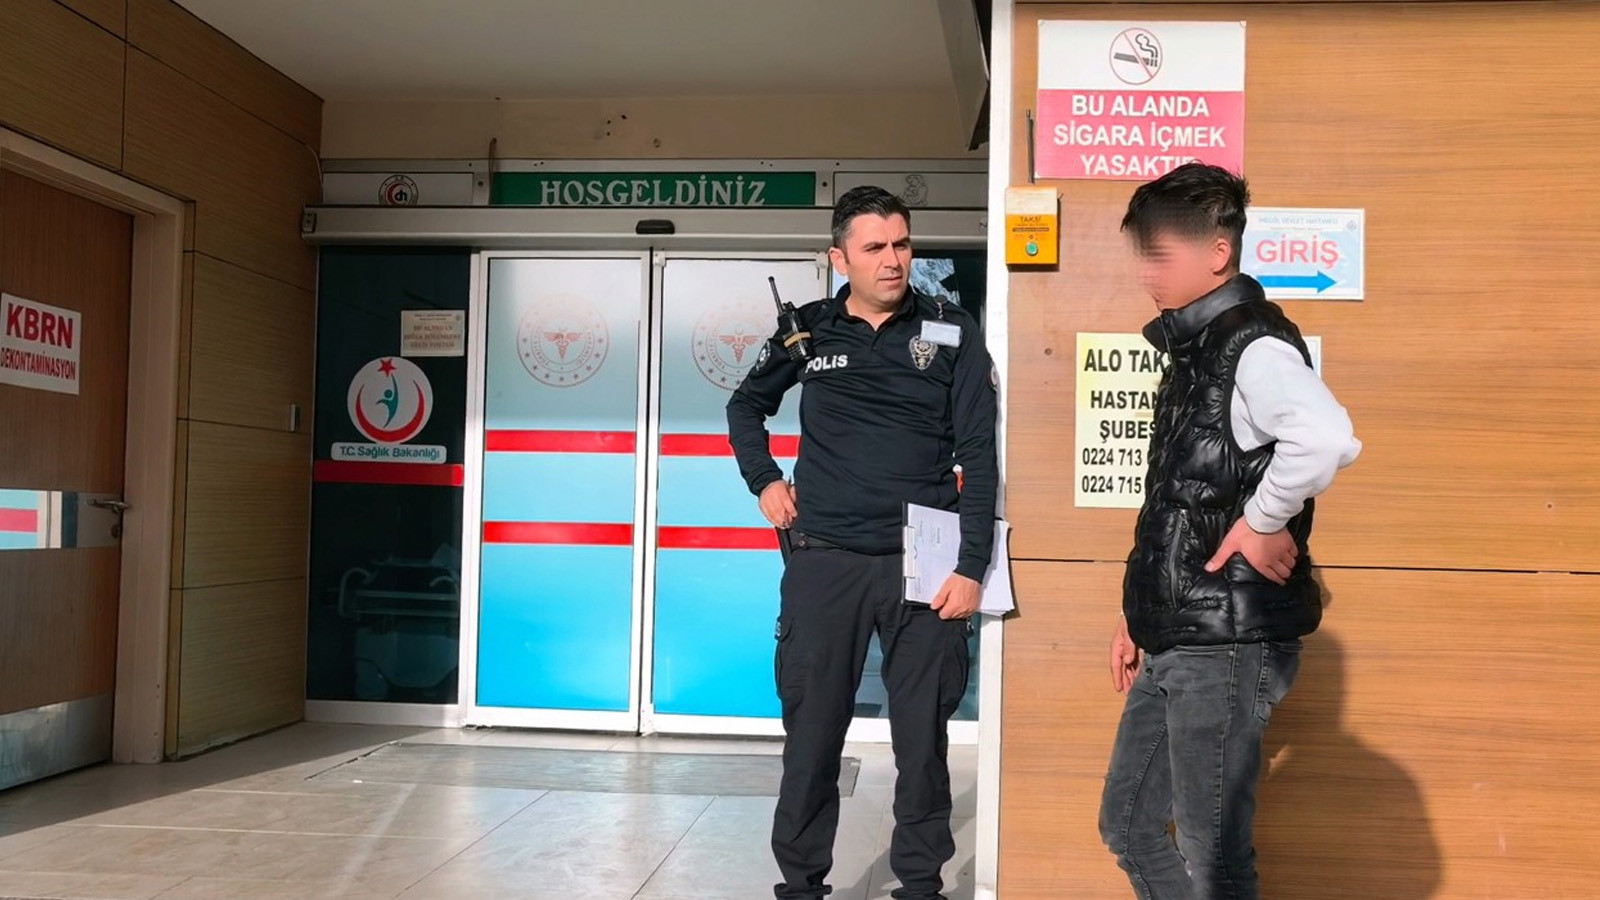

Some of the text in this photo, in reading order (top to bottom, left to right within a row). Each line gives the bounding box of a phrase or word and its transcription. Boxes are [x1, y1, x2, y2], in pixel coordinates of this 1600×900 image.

[1072, 94, 1210, 117] BU ALANDA
[1053, 120, 1226, 152] SİGARA İÇMEK
[1256, 233, 1339, 270] GİRİŞ
[6, 302, 74, 350] KBRN
[0, 346, 76, 380] DEKONTAMİNASYON
[1084, 349, 1122, 372] ALO
[357, 446, 390, 459] Sağlık
[1082, 447, 1114, 466] 0224
[1118, 448, 1143, 467] 713
[1081, 475, 1142, 494] 0224 715
